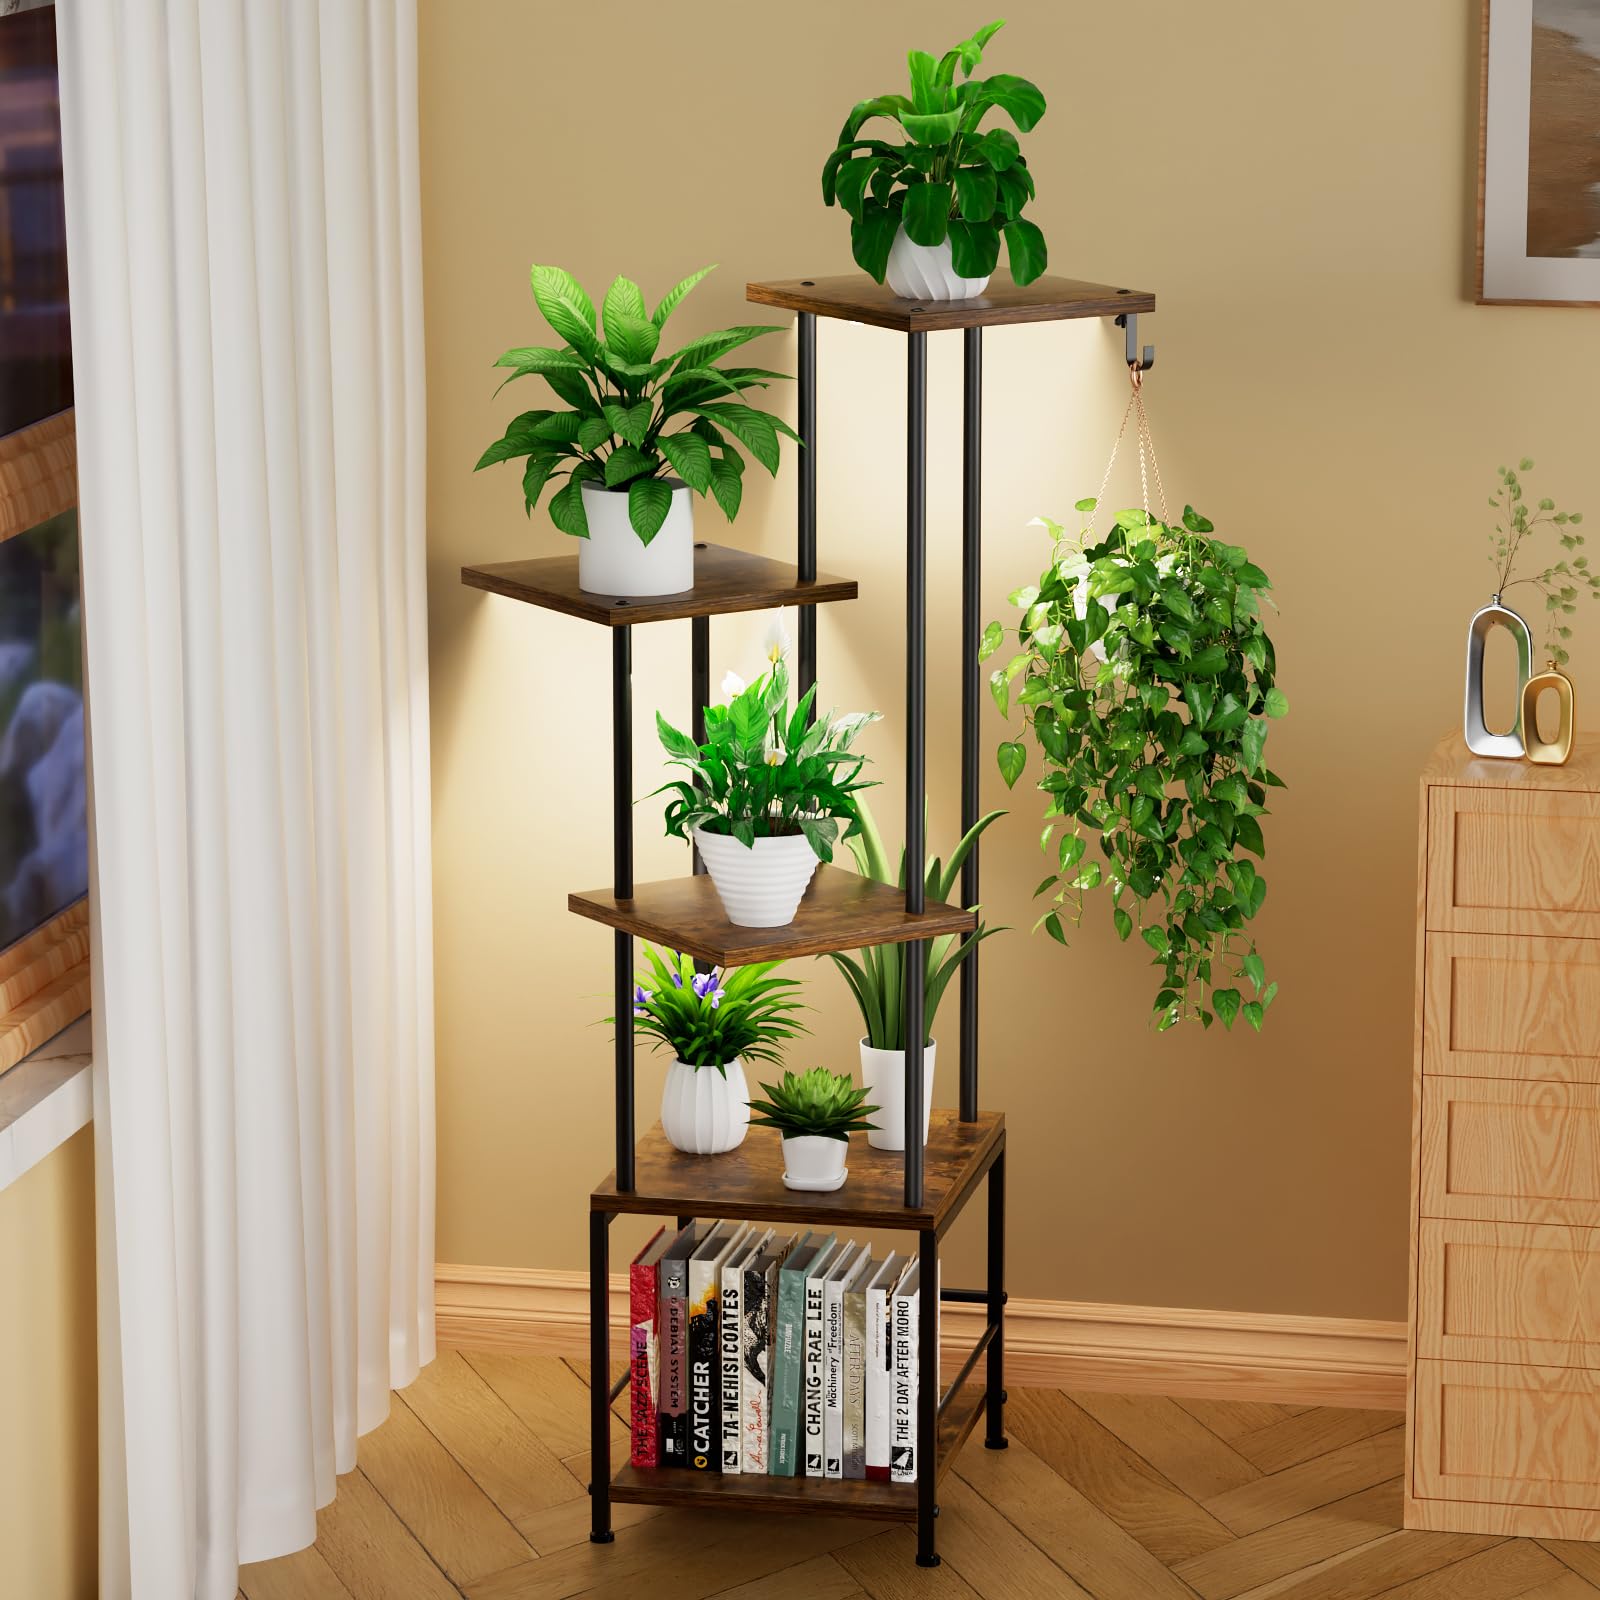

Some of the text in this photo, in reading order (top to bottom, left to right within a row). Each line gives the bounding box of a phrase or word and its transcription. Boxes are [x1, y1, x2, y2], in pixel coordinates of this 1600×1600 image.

[670, 1308, 678, 1355] DEBIAN
[723, 1288, 739, 1439] TA-NEHISI COATES
[806, 1288, 822, 1436] CHANG-RAE LEE
[827, 1302, 838, 1348] Freedom
[636, 1341, 648, 1457] THE JAZZ SCENE
[670, 1359, 679, 1408] SYSTEM
[693, 1361, 710, 1453] CATCHER
[827, 1356, 839, 1408] Machinery
[896, 1301, 909, 1442] THE 2 DAY AFTER MORO
